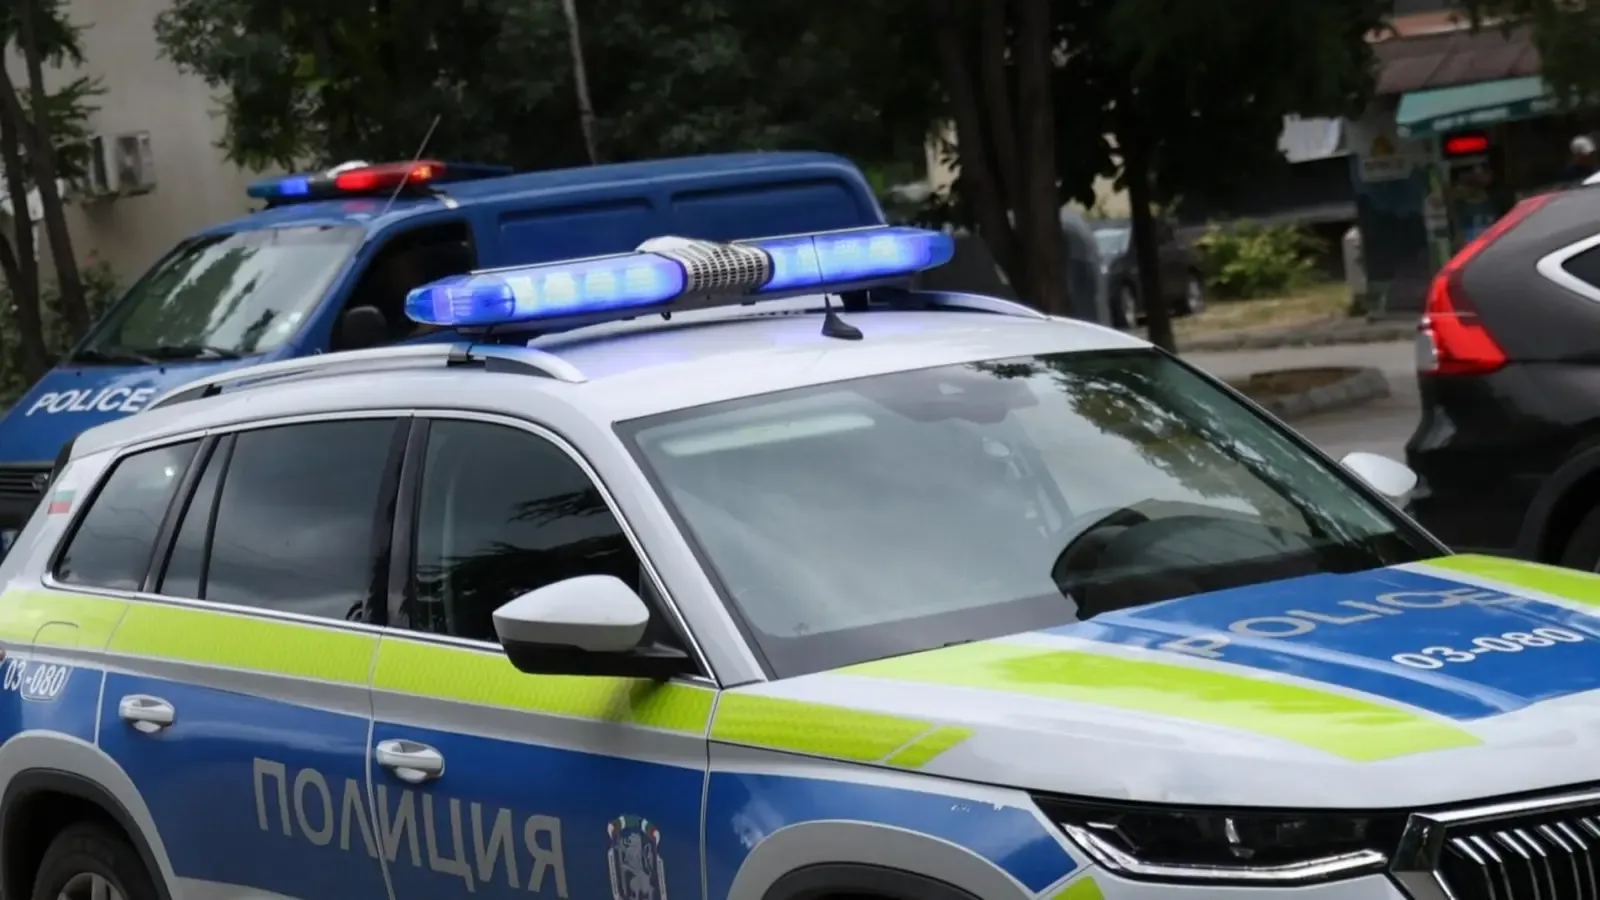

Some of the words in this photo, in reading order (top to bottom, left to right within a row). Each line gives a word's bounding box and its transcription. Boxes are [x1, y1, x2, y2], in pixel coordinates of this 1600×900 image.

[25, 387, 156, 417] POLICE
[1160, 588, 1525, 658] POLICE
[1391, 627, 1584, 670] 03-080
[4, 659, 67, 697] 03-080
[253, 757, 568, 898] ПОЛИЦИЯ
